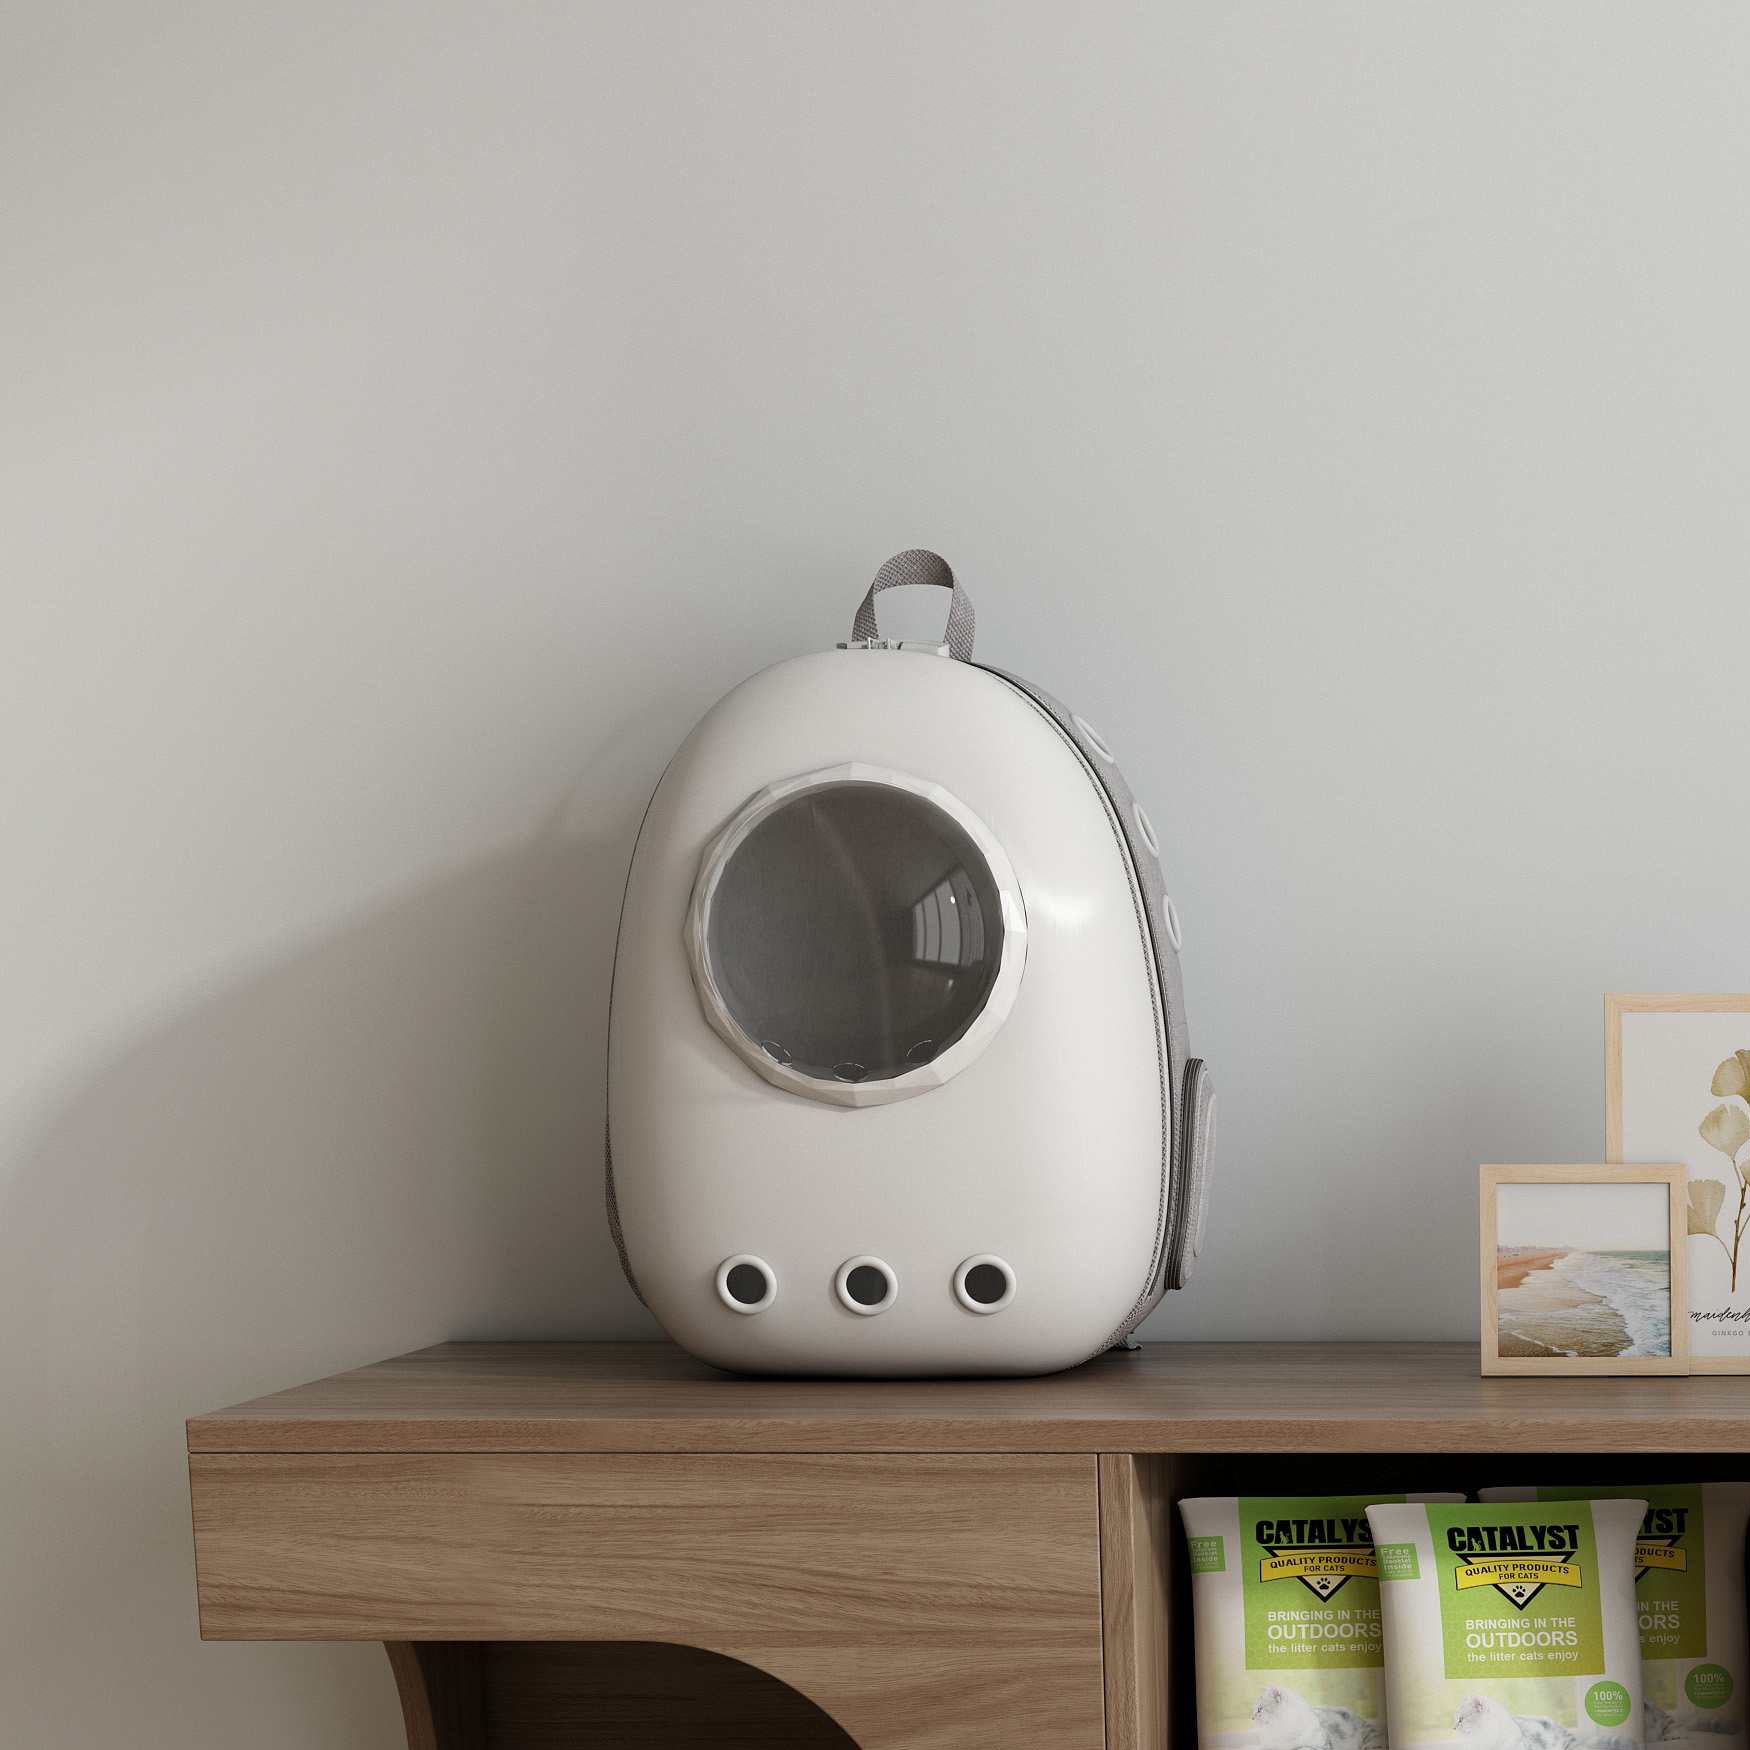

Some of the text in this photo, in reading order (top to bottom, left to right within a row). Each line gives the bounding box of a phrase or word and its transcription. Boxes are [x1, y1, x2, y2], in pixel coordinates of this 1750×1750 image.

[1256, 1519, 1375, 1544] CATALYS
[1447, 1525, 1579, 1552] CATALYST
[1270, 1557, 1316, 1568] QUALITY
[1318, 1557, 1376, 1567] PRODUCTS
[1465, 1563, 1569, 1576] QUALITY PRODUCTS
[1654, 1601, 1680, 1611] THE
[1268, 1609, 1381, 1621] BRINGING IN THE
[1466, 1617, 1576, 1629] BRINGING IN THE
[1267, 1623, 1382, 1640] OUTDOORS
[1466, 1630, 1578, 1649] OUTDOORS
[1650, 1635, 1680, 1644] enjoy
[1268, 1643, 1286, 1653] the
[1292, 1643, 1317, 1653] litter
[1322, 1643, 1345, 1652] cats
[1467, 1651, 1578, 1662] the litter cats enjoy
[1695, 1673, 1724, 1683] 100%
[1594, 1691, 1623, 1700] 100%
